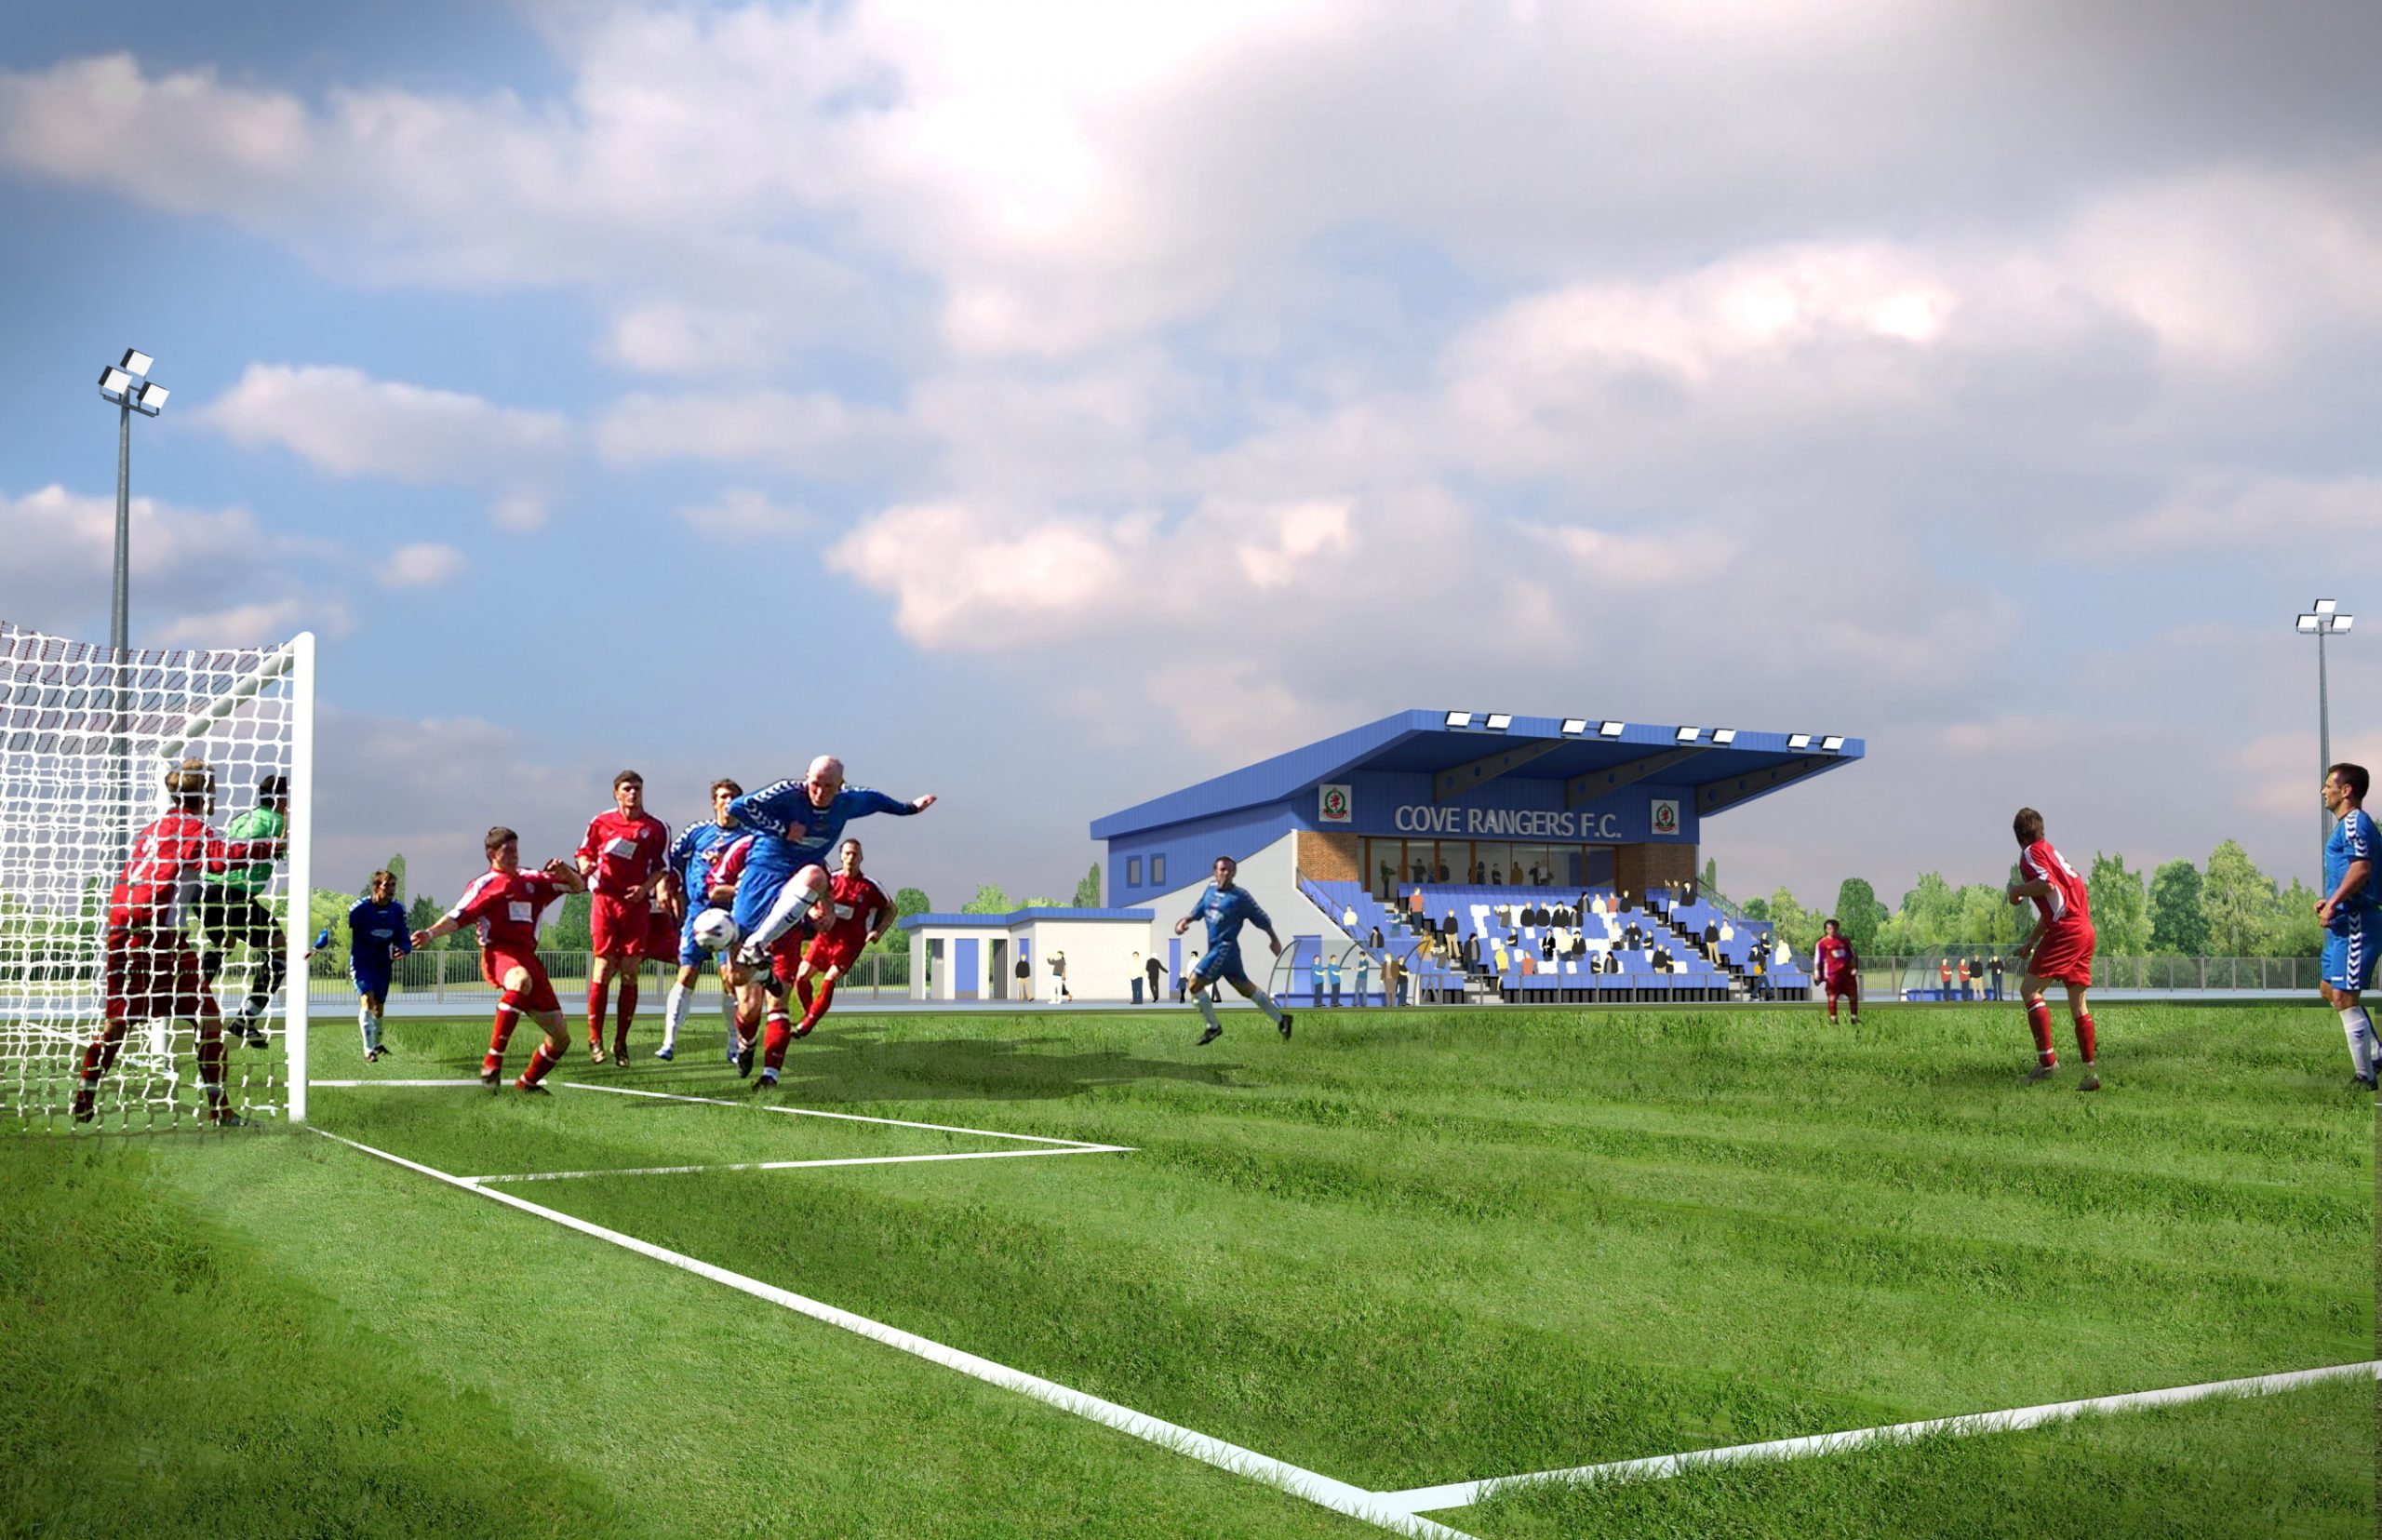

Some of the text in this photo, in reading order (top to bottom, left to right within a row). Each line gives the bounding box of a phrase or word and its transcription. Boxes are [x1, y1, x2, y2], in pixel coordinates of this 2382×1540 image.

[1395, 805, 1622, 838] COVE RANGERS F.C.
